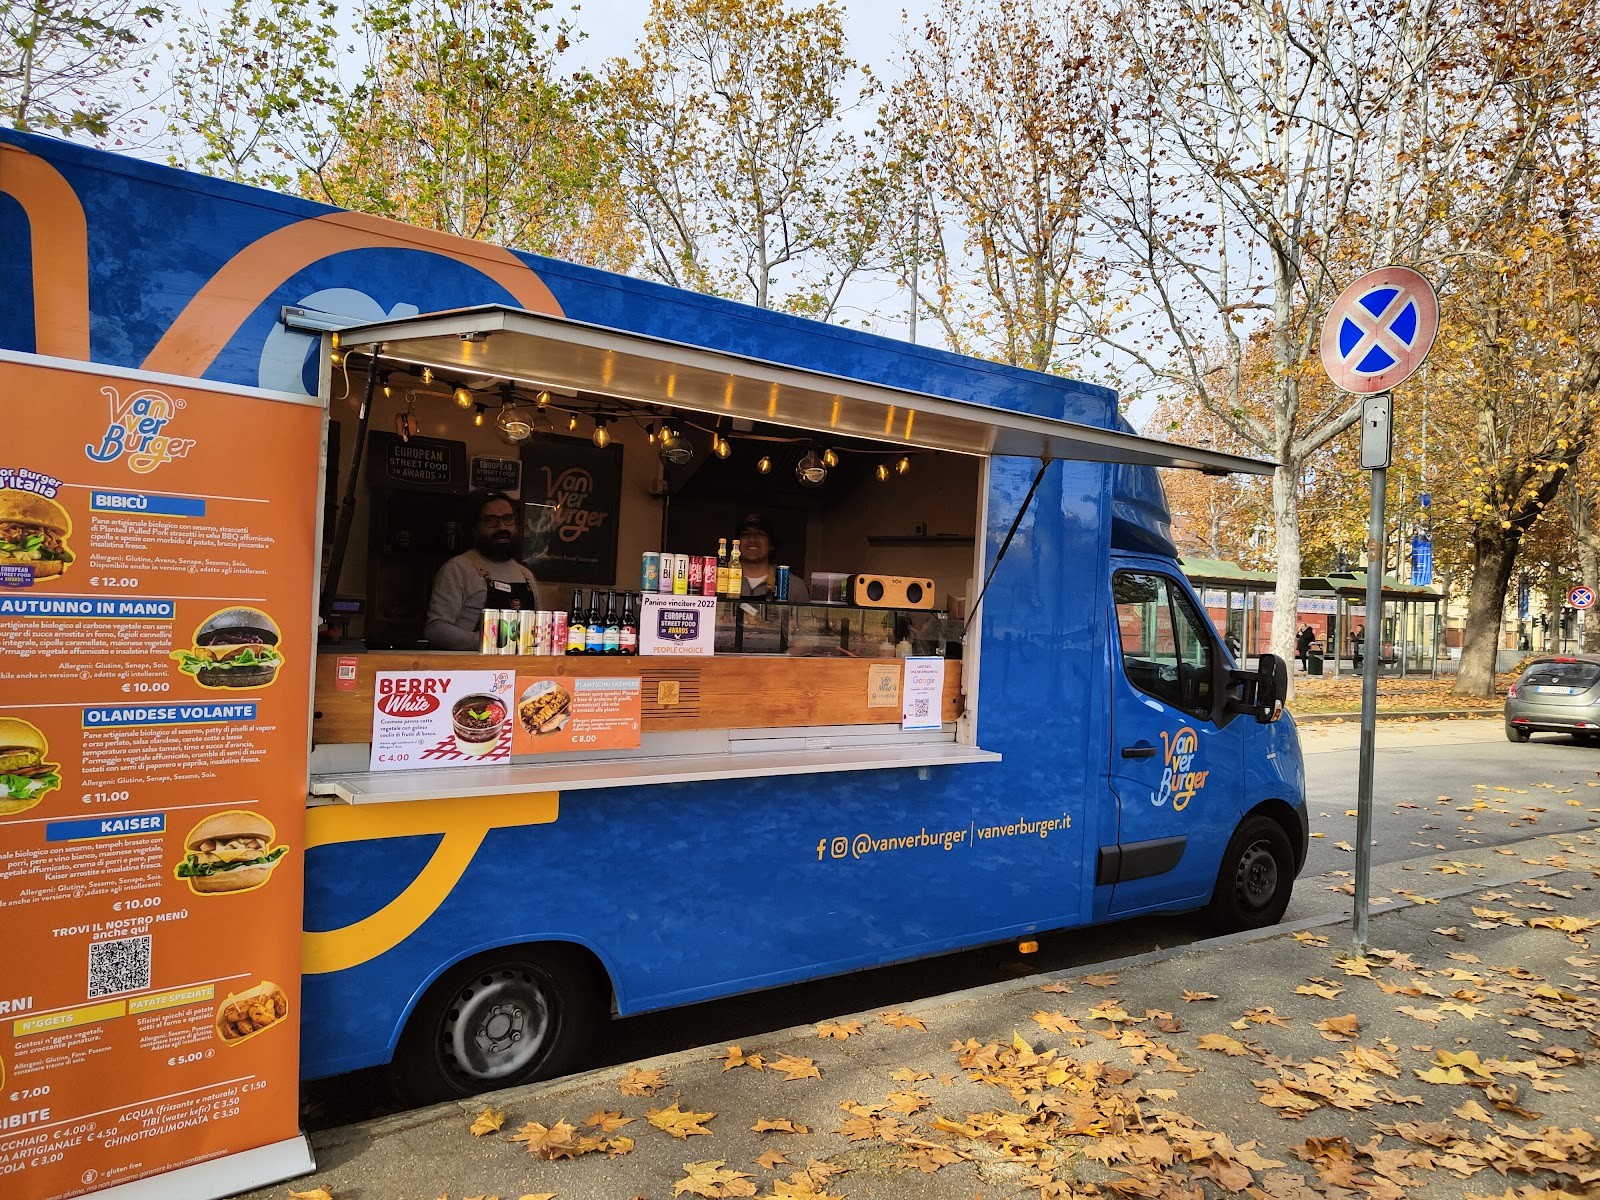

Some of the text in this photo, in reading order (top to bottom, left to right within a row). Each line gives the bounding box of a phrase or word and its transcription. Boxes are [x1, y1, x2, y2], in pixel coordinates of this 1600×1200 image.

[100, 386, 175, 424] Van
[125, 414, 168, 435] ver
[85, 423, 196, 474] Burger
[394, 446, 442, 461] EUROPEAN
[390, 458, 448, 471] STREET FOOD
[480, 461, 512, 470] EUROPEAN
[20, 469, 62, 488] Burger
[402, 468, 435, 479] AWARDS
[540, 465, 593, 498] Van
[96, 494, 147, 510] BIBICÙ
[92, 517, 110, 525] Pane
[111, 519, 147, 528] artigianale
[149, 520, 178, 530] biologico
[219, 525, 248, 533] straccetti
[528, 500, 607, 542] Burger
[100, 525, 127, 534] Planted
[129, 527, 150, 535] Pulled
[152, 528, 168, 536] Pork
[170, 529, 197, 538] stracotti
[90, 577, 138, 587] € 12.00
[1, 600, 171, 615] AUTUNNO IN MANO
[644, 598, 667, 606] Panino
[668, 599, 696, 607] vincitore
[664, 612, 694, 621] EUROPEAN
[0, 621, 40, 630] artigianale
[41, 621, 74, 630] biologico
[113, 622, 141, 631] vegetale
[122, 683, 170, 692] € 10.00
[379, 678, 451, 694] BERRY
[913, 676, 935, 685] Google
[385, 693, 430, 714] White
[88, 706, 252, 722] OLANDESE VOLANTE
[103, 729, 140, 739] artigianale
[140, 728, 170, 737] biologico
[206, 726, 222, 735] patty
[231, 725, 248, 734] piselli
[256, 725, 276, 733] vapore
[579, 735, 596, 743] 8.00
[1160, 726, 1198, 766] Van
[379, 754, 409, 762] € 4.00
[1172, 754, 1194, 773] ver
[82, 791, 129, 804] € 11.00
[1151, 768, 1210, 811] Burger
[101, 817, 161, 833] KAISER
[852, 828, 967, 860] @vanverburger
[977, 812, 1071, 838] vanverburger.it
[45, 872, 68, 880] Kaiser
[70, 868, 100, 878] arrostite
[106, 863, 139, 873] insalatina
[113, 897, 161, 911] € 10.00
[52, 926, 90, 937] TROVI
[106, 916, 153, 929] NOSTRO
[156, 909, 188, 922] MENÙ
[93, 924, 149, 939] anche qui
[130, 988, 213, 1009] PATATE SPEZIATE
[15, 1038, 43, 1049] Gustosi
[168, 1052, 202, 1066] € 5.00
[10, 1085, 50, 1100] € 7.00
[118, 1109, 154, 1123] ACQUA
[156, 1100, 194, 1114] (frizzante
[202, 1087, 238, 1102] naturale)
[242, 1085, 249, 1093] €
[251, 1080, 266, 1090] 1.50
[142, 1097, 239, 1127] TIBI (water kefir) € 3.50
[54, 1130, 61, 1139] €
[64, 1124, 85, 1137] 4.00
[104, 1107, 239, 1148] CHINOTTO/LIMONATA € 3.50
[12, 1127, 118, 1159] ARTIGIANALE € 4.50
[31, 1158, 38, 1167] €
[41, 1152, 64, 1165] 3.00
[106, 1161, 142, 1177] gluten free
